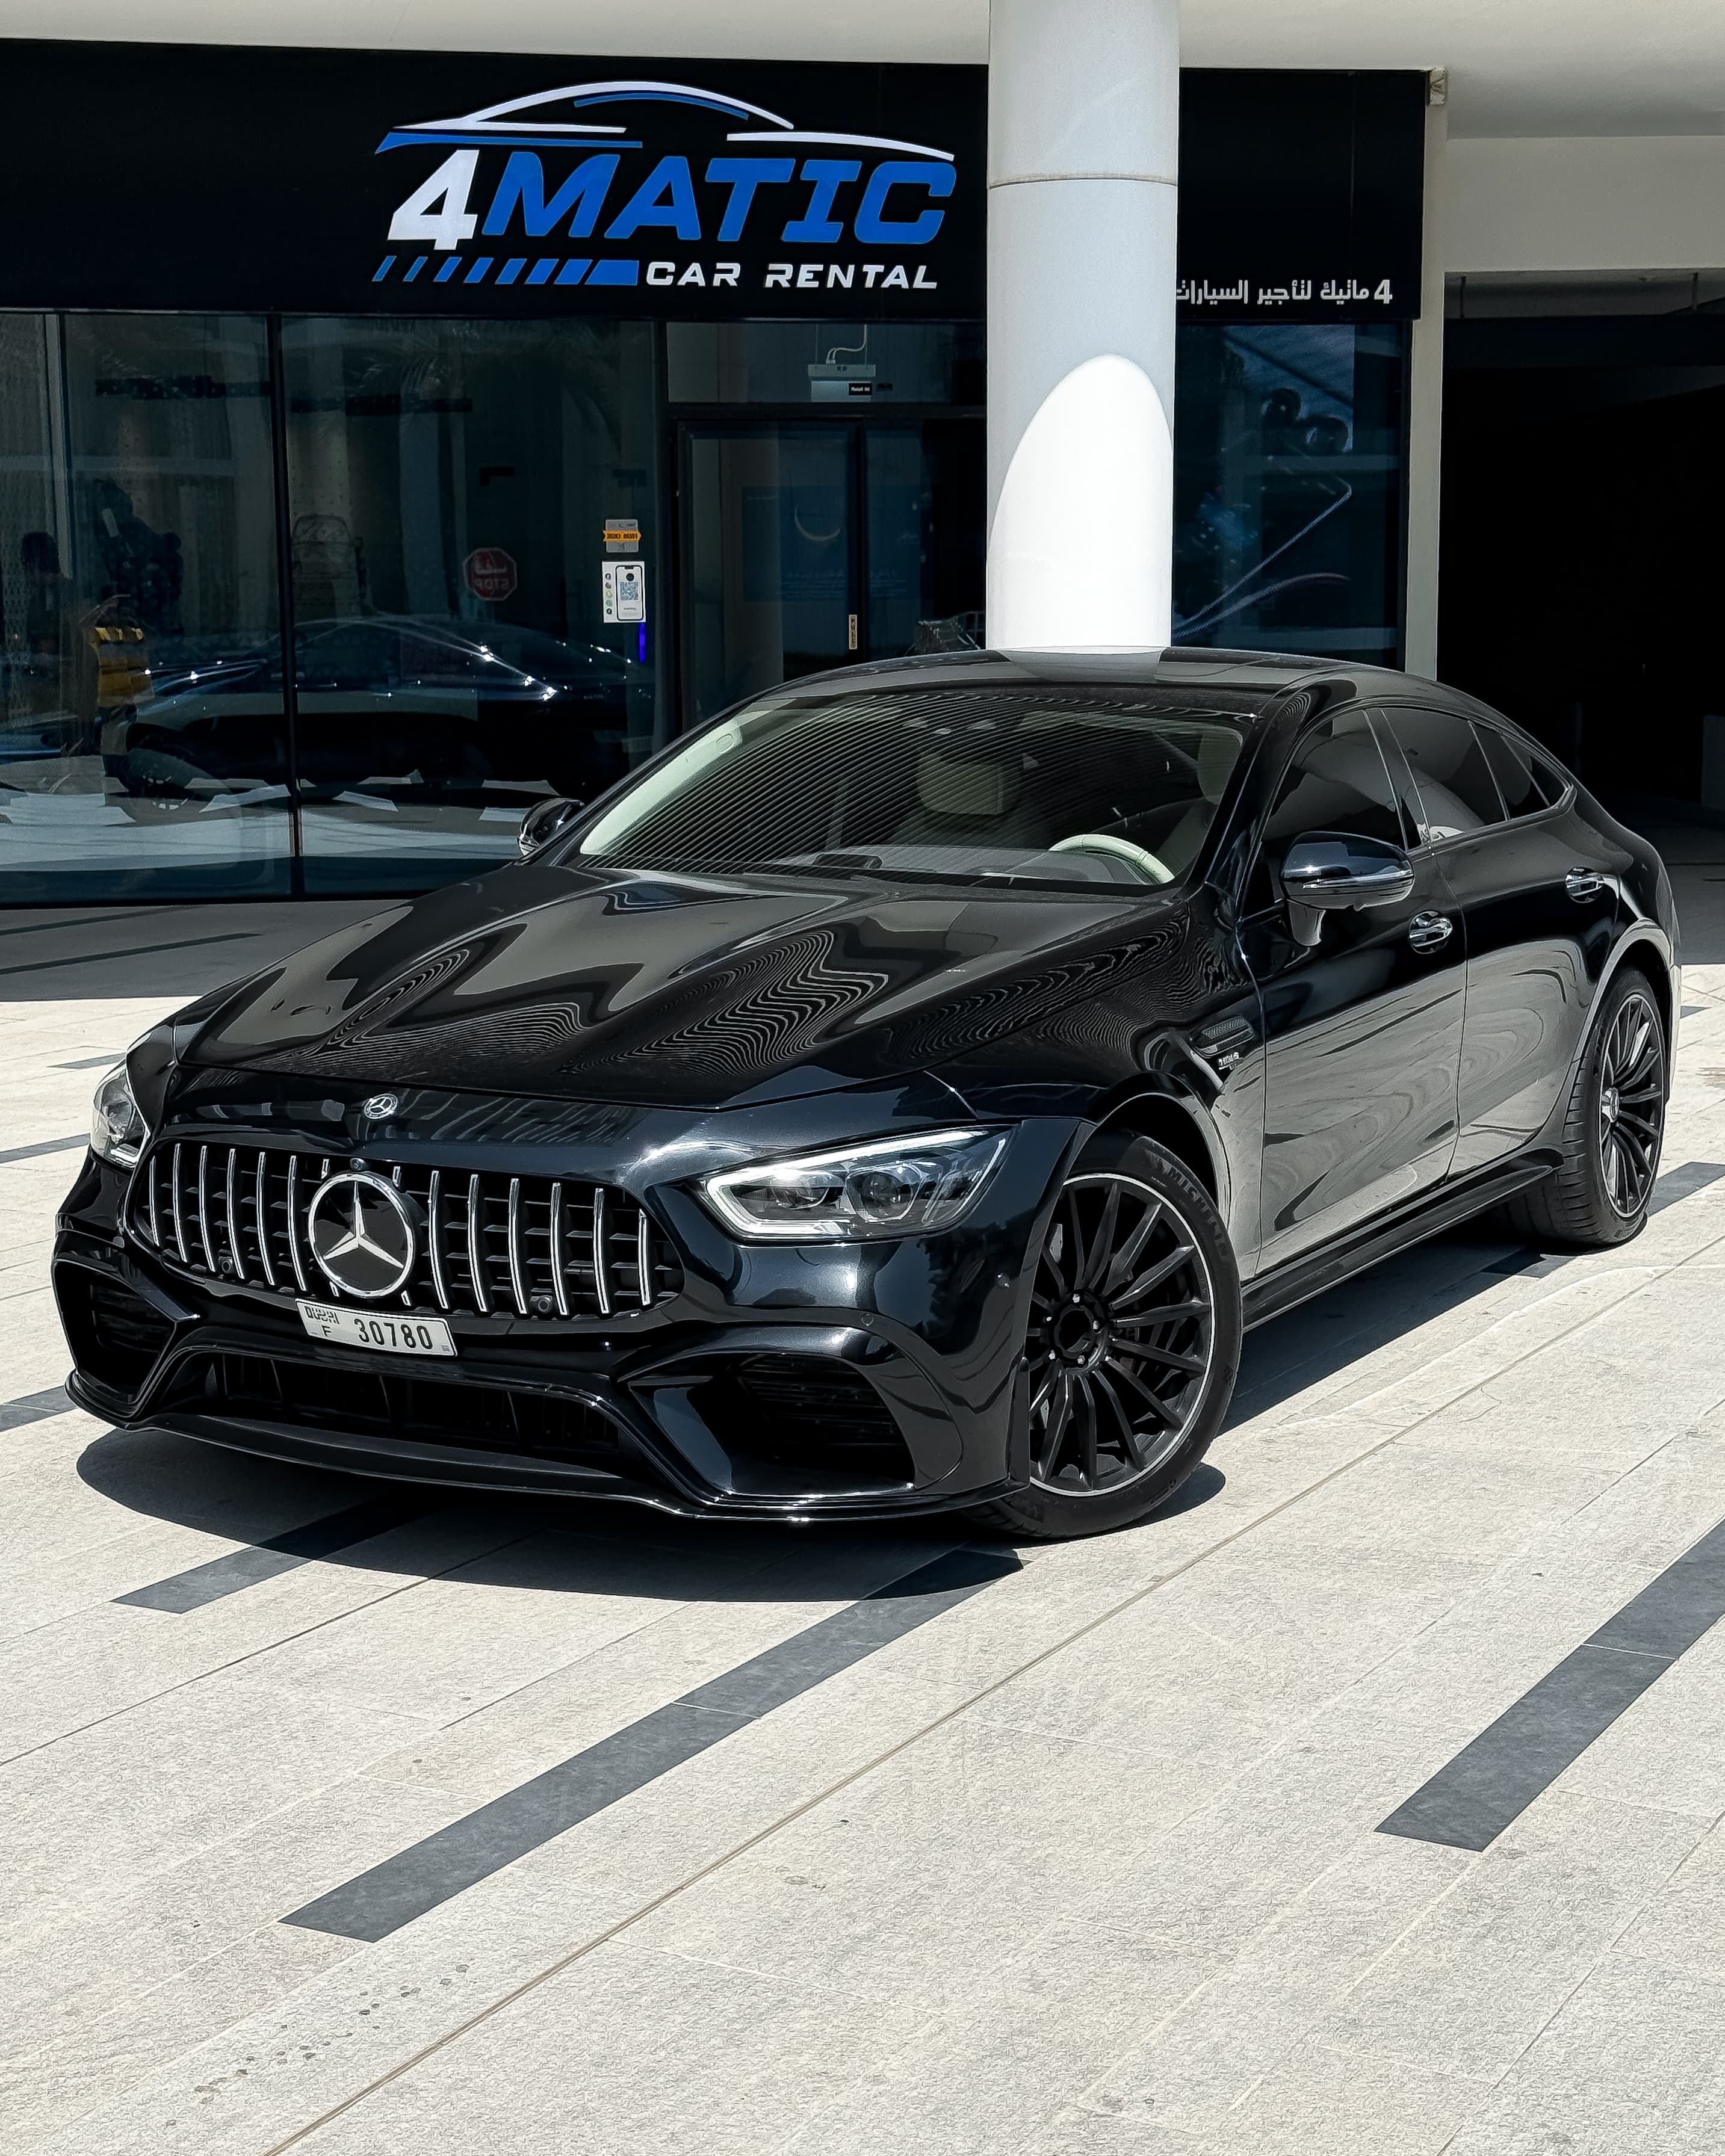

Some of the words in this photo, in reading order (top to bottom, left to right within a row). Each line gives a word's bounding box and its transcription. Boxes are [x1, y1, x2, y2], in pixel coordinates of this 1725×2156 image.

[387, 149, 956, 250] 4MATIC
[646, 261, 741, 287] CAR
[764, 263, 938, 289] RENTAL
[1257, 279, 1312, 305] لتأجير
[321, 1324, 332, 1337] F
[353, 1318, 433, 1350] 30780
